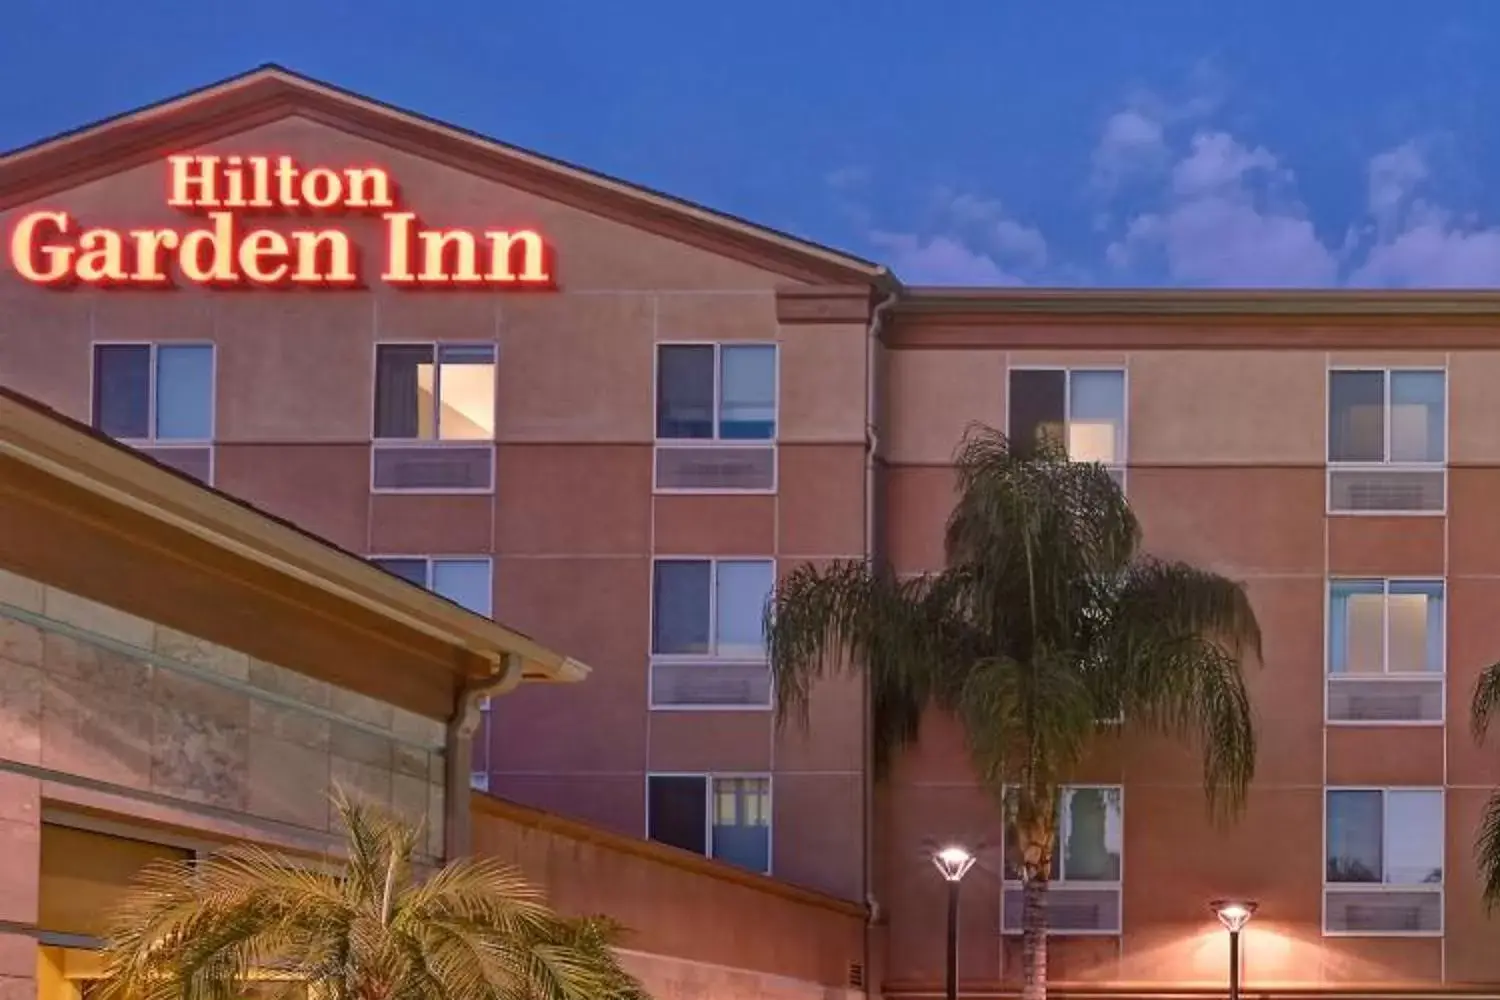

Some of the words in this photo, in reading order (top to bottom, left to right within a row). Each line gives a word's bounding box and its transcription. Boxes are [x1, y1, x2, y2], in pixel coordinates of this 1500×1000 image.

[166, 154, 394, 208] Hilton
[10, 210, 356, 284] Garden
[380, 211, 550, 283] Inn
